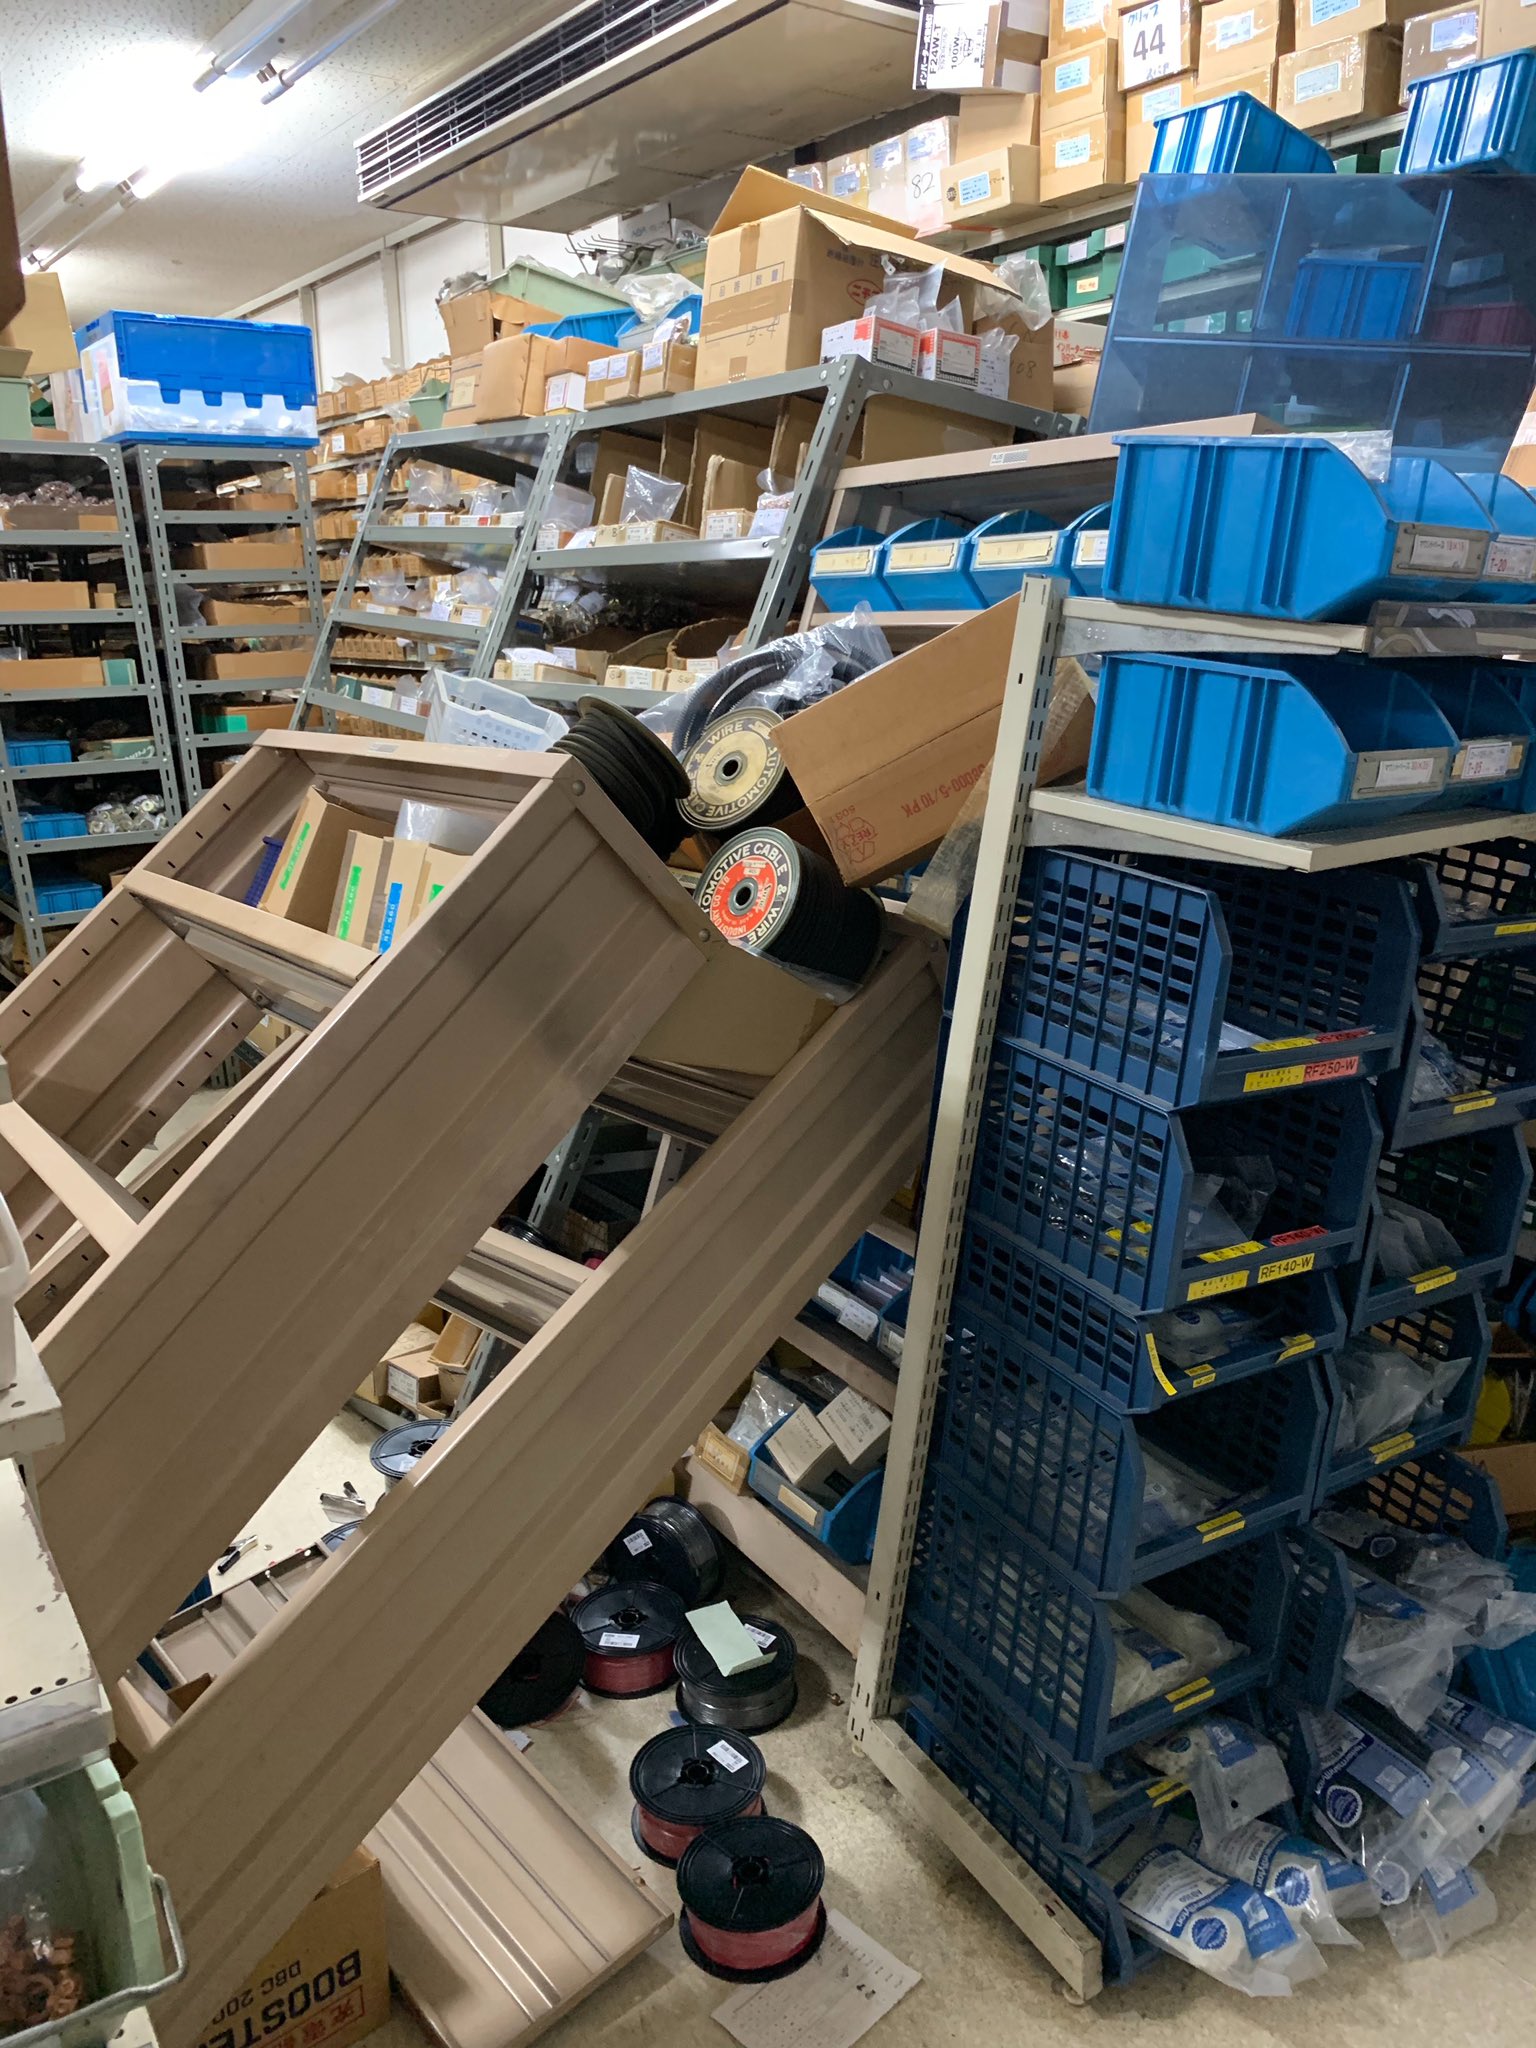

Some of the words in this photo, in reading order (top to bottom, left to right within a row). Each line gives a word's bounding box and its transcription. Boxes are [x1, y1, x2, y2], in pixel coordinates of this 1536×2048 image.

[929, 23, 942, 75] F24W-T
[1132, 23, 1166, 61] 44
[911, 171, 936, 199] 82
[707, 720, 744, 745] WIRE
[705, 746, 778, 817] AUTOMOTIVE
[901, 805, 922, 819] PK
[753, 842, 787, 877] CABLE
[776, 883, 787, 896] &
[747, 906, 781, 945] WIRE
[1305, 1058, 1357, 1079] RF250-W
[1260, 1255, 1313, 1280] RF140-W
[260, 1959, 302, 1996] DBC
